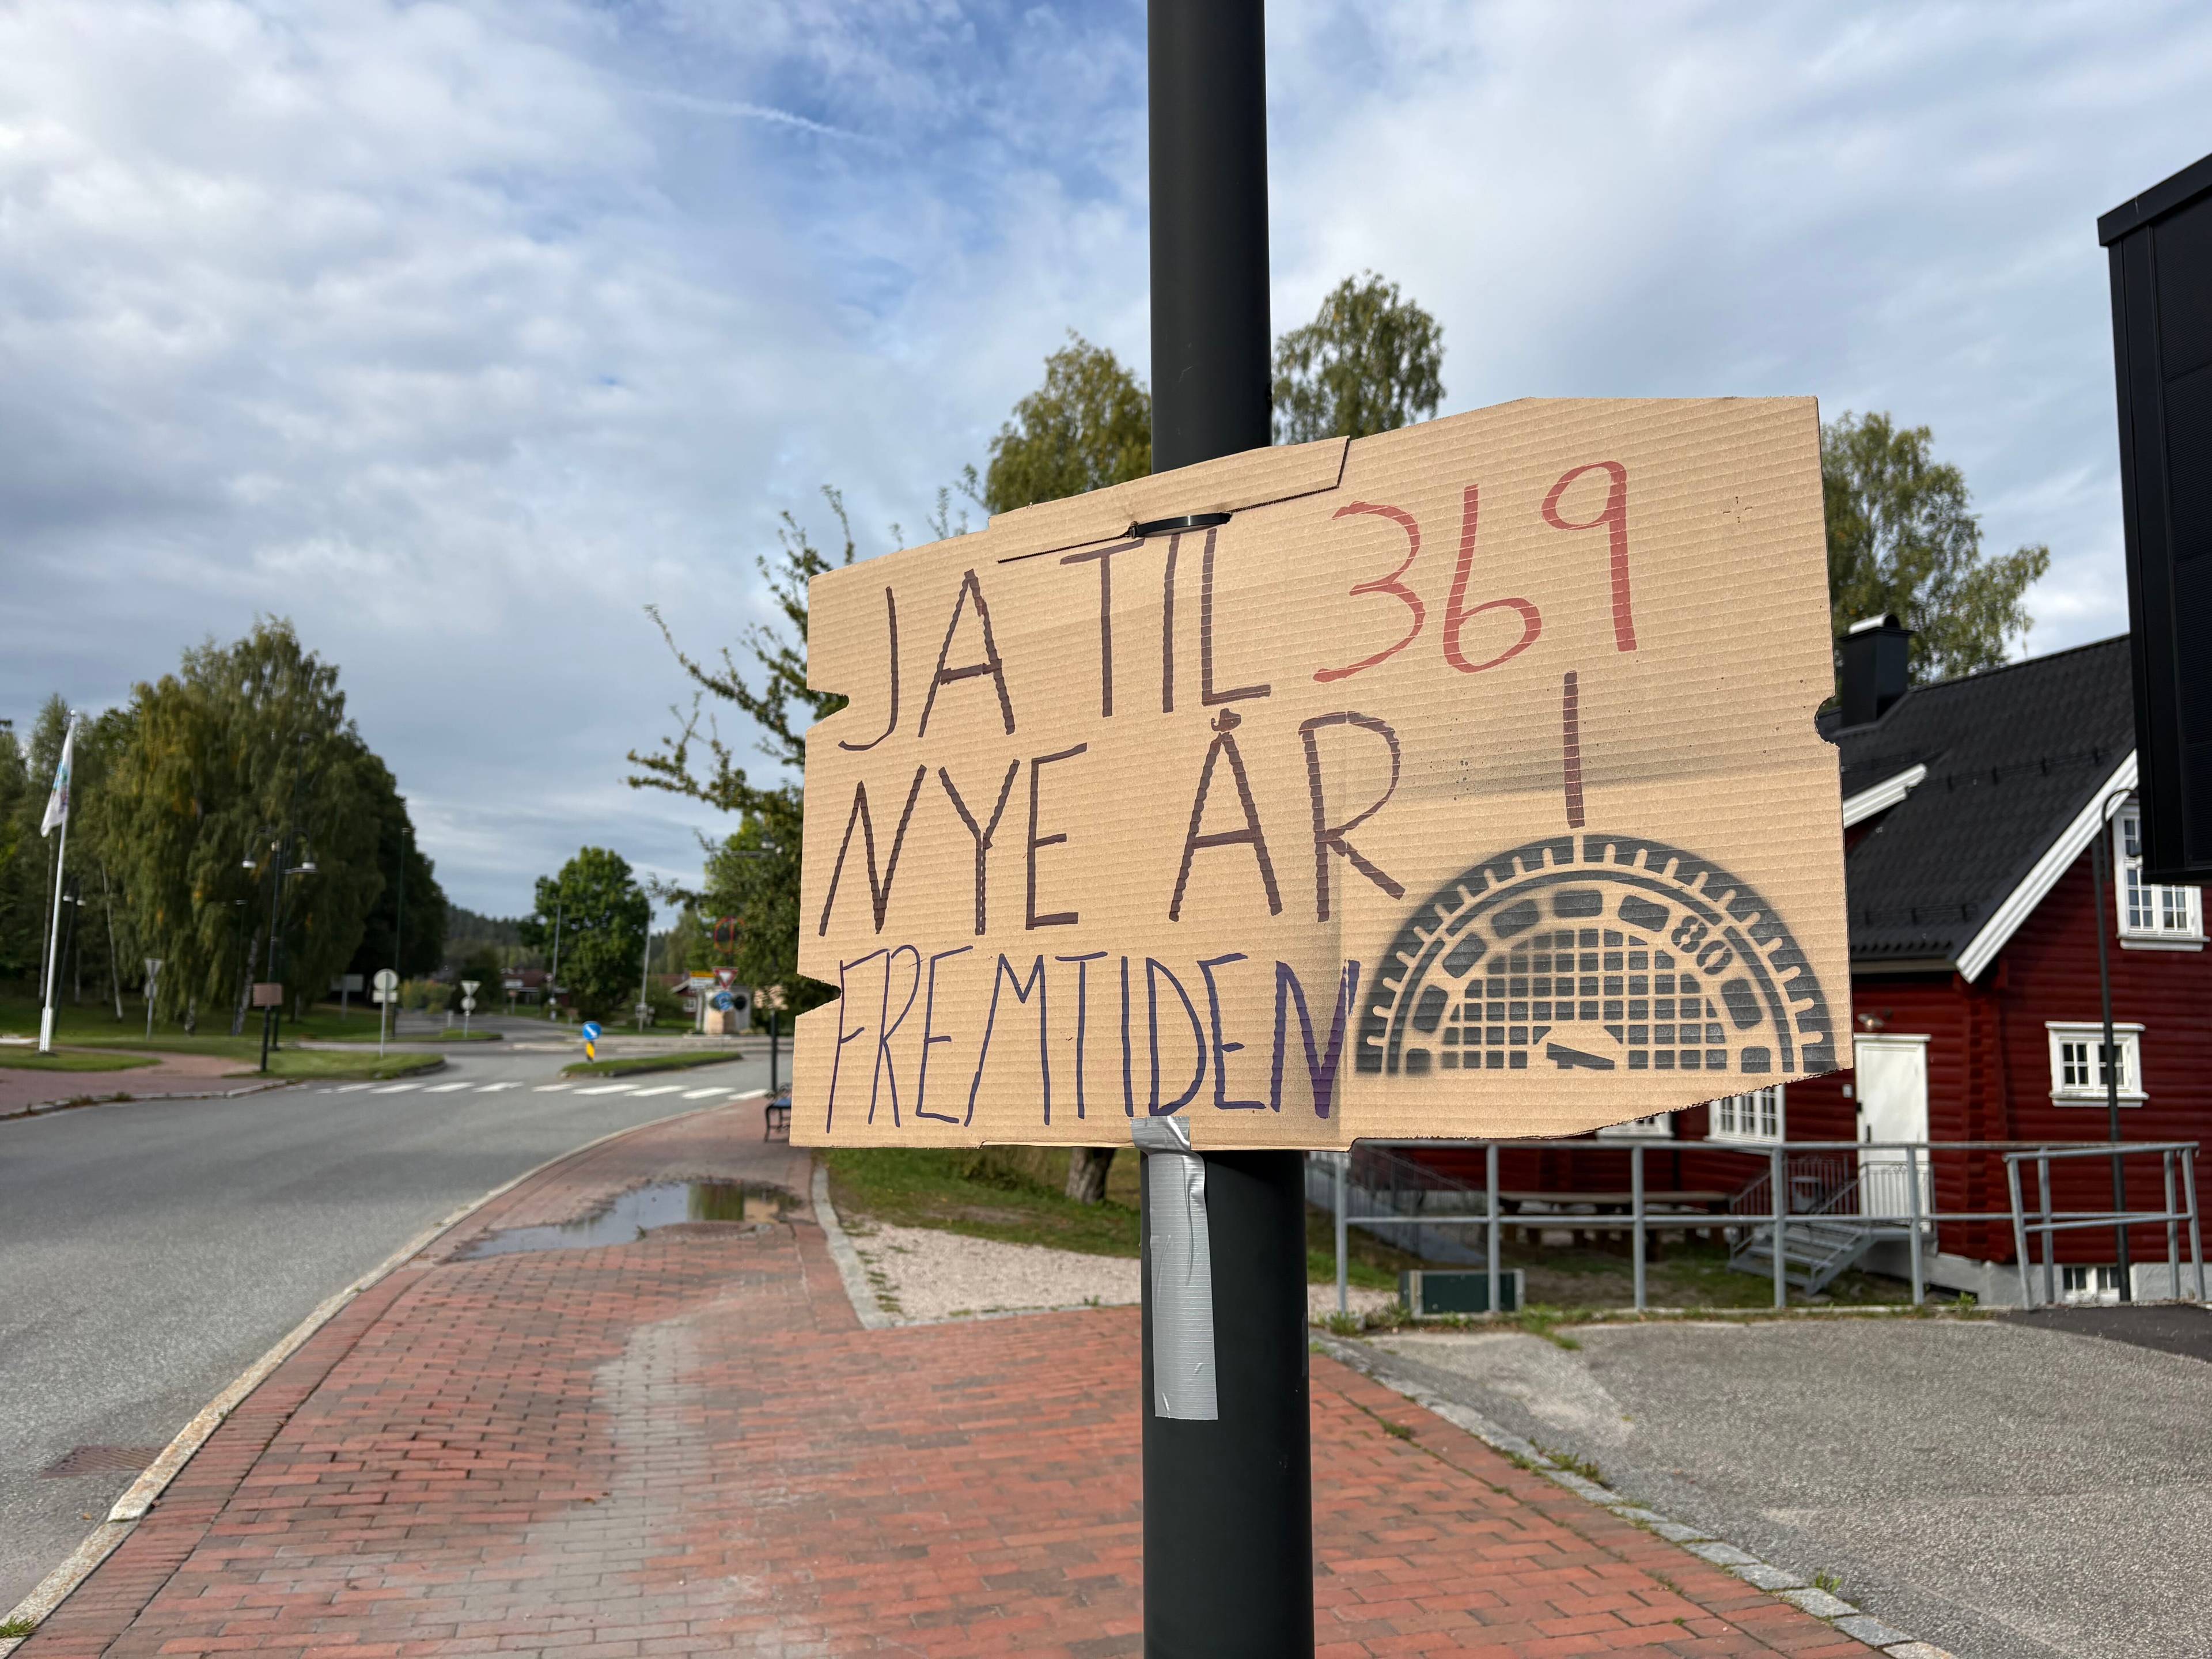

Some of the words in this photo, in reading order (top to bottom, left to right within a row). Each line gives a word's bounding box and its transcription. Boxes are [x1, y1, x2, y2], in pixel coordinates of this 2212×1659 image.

[838, 569, 1016, 751] JA
[1060, 528, 1271, 718] TIL
[1313, 460, 1638, 683] 369
[819, 743, 1088, 937] NYE
[1168, 708, 1406, 923] ÅR
[826, 944, 1360, 1134] FREMTIDEN
[1671, 915, 1732, 975] 80
